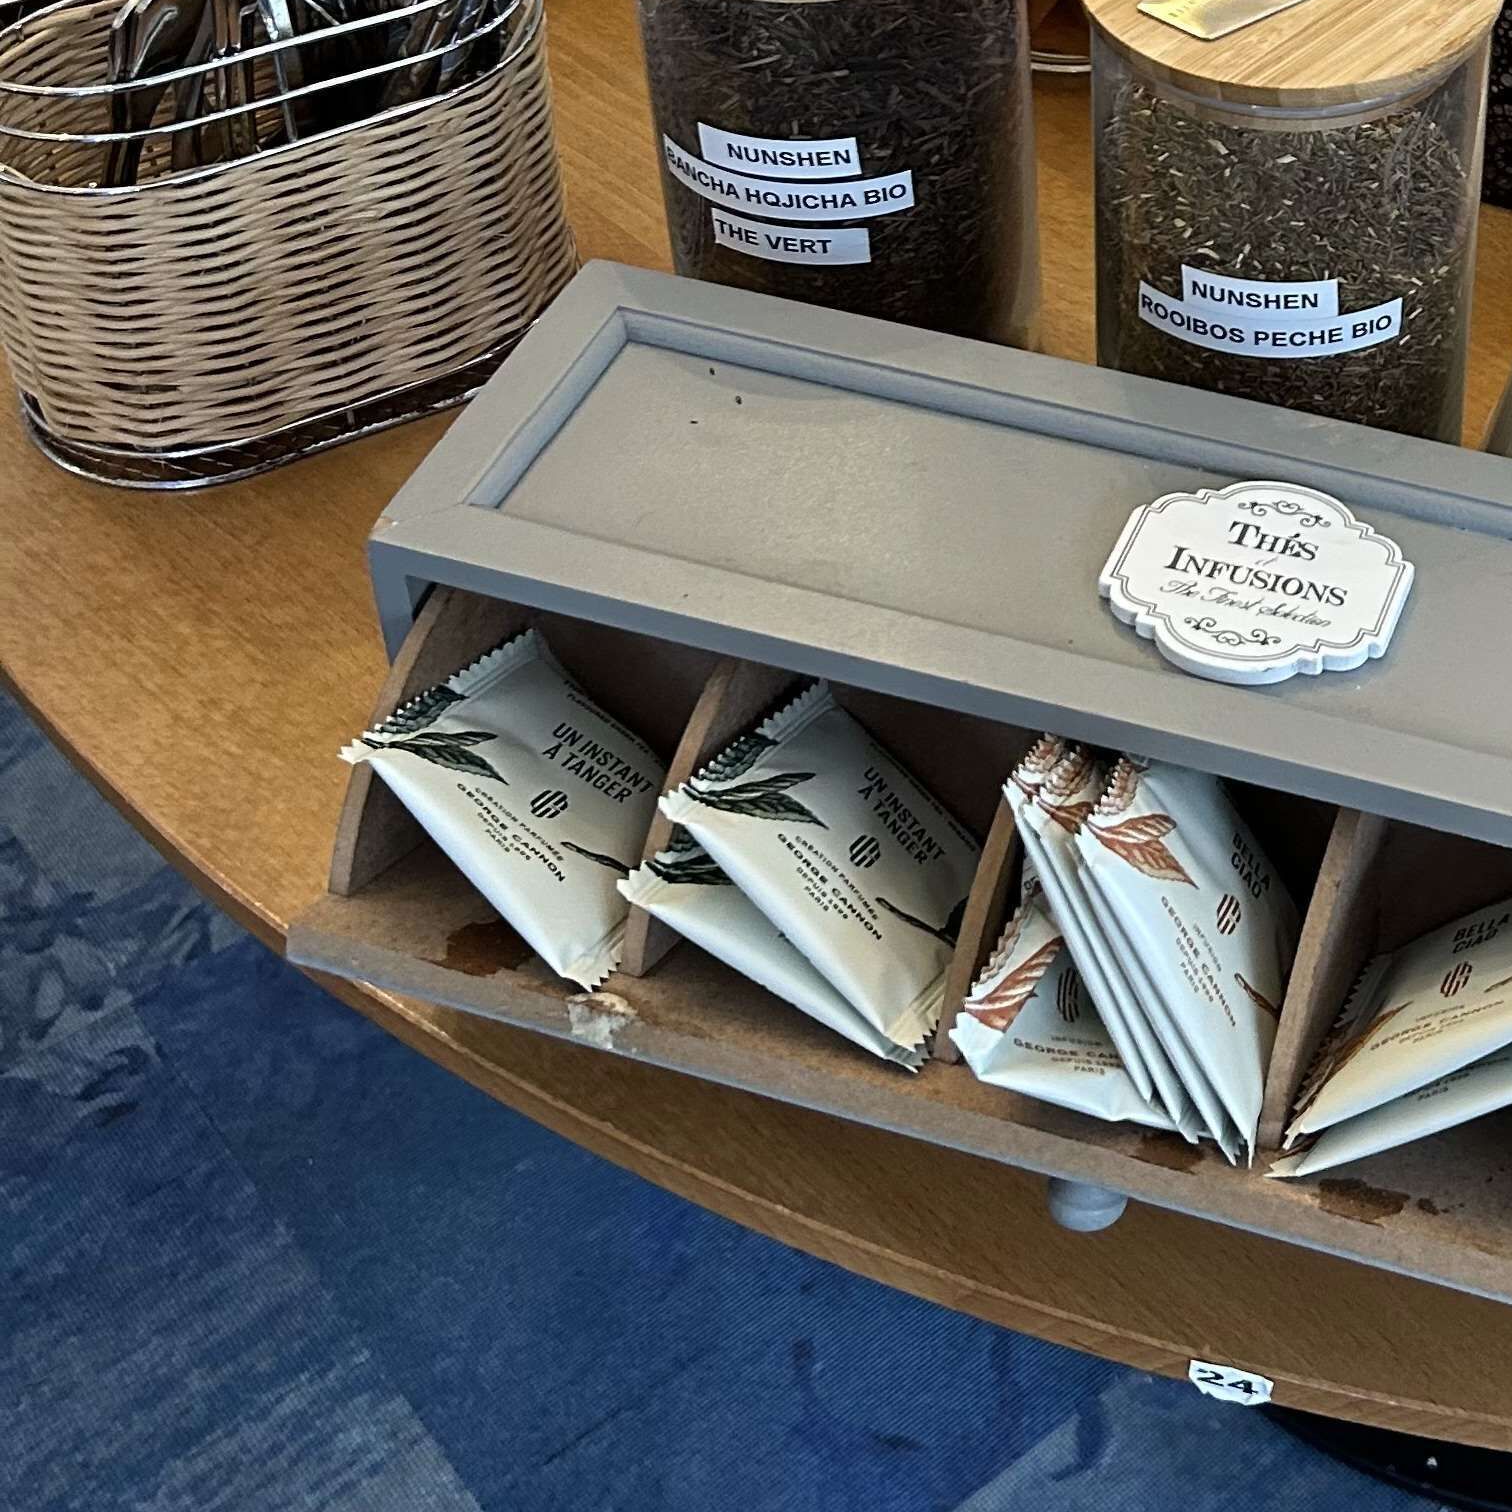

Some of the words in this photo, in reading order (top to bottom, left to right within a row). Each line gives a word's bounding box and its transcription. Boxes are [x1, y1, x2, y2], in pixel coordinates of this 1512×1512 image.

[666, 145, 740, 200] BANCHA
[864, 183, 907, 205] BIO
[727, 143, 851, 167] NUNSHEN
[715, 218, 759, 246] THE
[765, 234, 832, 254] VERT
[1141, 293, 1245, 343] ROOIBOS
[1253, 327, 1343, 346] PECHE
[1352, 315, 1392, 339] BIO
[1191, 280, 1319, 310] NUNSHEN
[1160, 580, 1201, 598] The
[1164, 545, 1348, 607] INFUSIONS
[552, 722, 584, 747] UN
[579, 740, 654, 793] INSTANT
[561, 752, 633, 803] TANGER
[457, 783, 508, 830] GEORGE
[512, 834, 565, 882] CANNON
[863, 767, 888, 793] UN
[884, 792, 947, 860] INSTANT
[873, 799, 928, 864] TANGER
[777, 833, 829, 884] GEORGE
[831, 888, 882, 940] CANNON
[1231, 852, 1262, 899] CIAO
[1232, 832, 1272, 890] BELLA
[1161, 895, 1200, 960] GEORGE
[1452, 929, 1498, 954] CIAO
[1453, 913, 1511, 942] BELLA
[1013, 1037, 1079, 1057] GEORGE
[1197, 1367, 1259, 1395] 24
